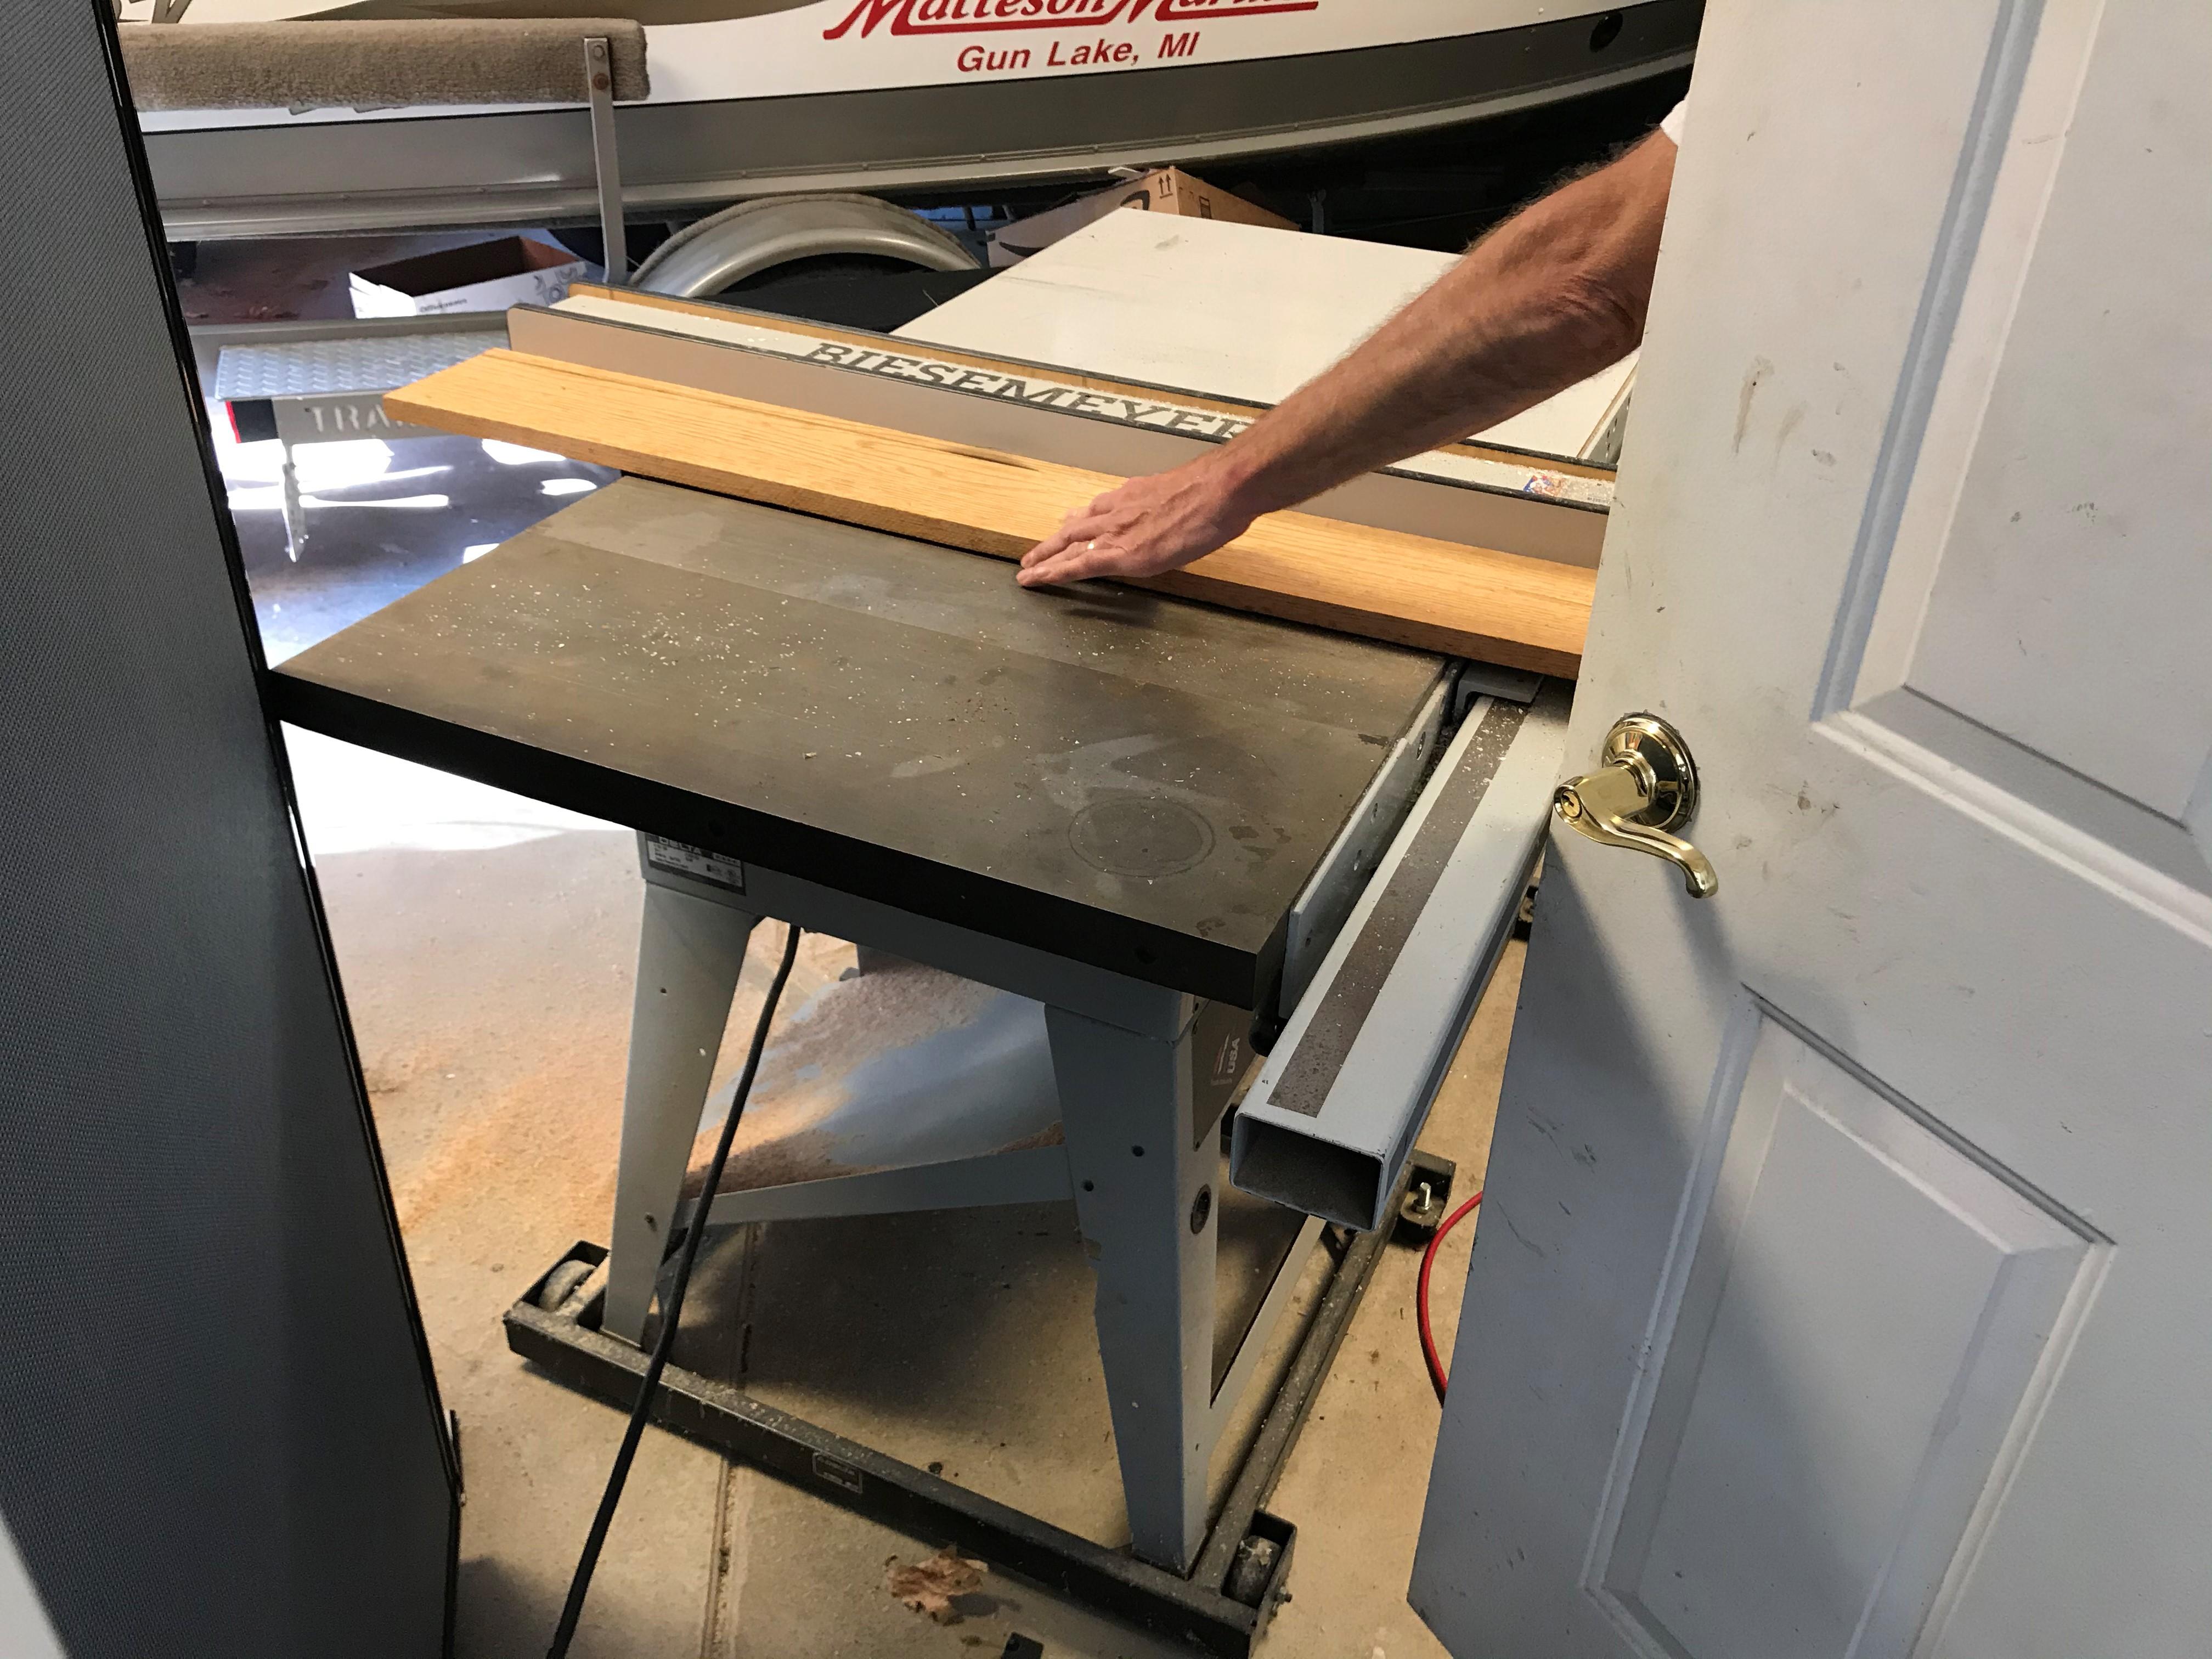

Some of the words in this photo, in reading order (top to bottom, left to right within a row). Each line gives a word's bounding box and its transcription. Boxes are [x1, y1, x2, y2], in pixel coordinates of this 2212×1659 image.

[957, 45, 1031, 72] Gun
[1047, 38, 1139, 67] Lake,
[1157, 31, 1200, 59] MI
[1227, 1037, 1240, 1074] USA
